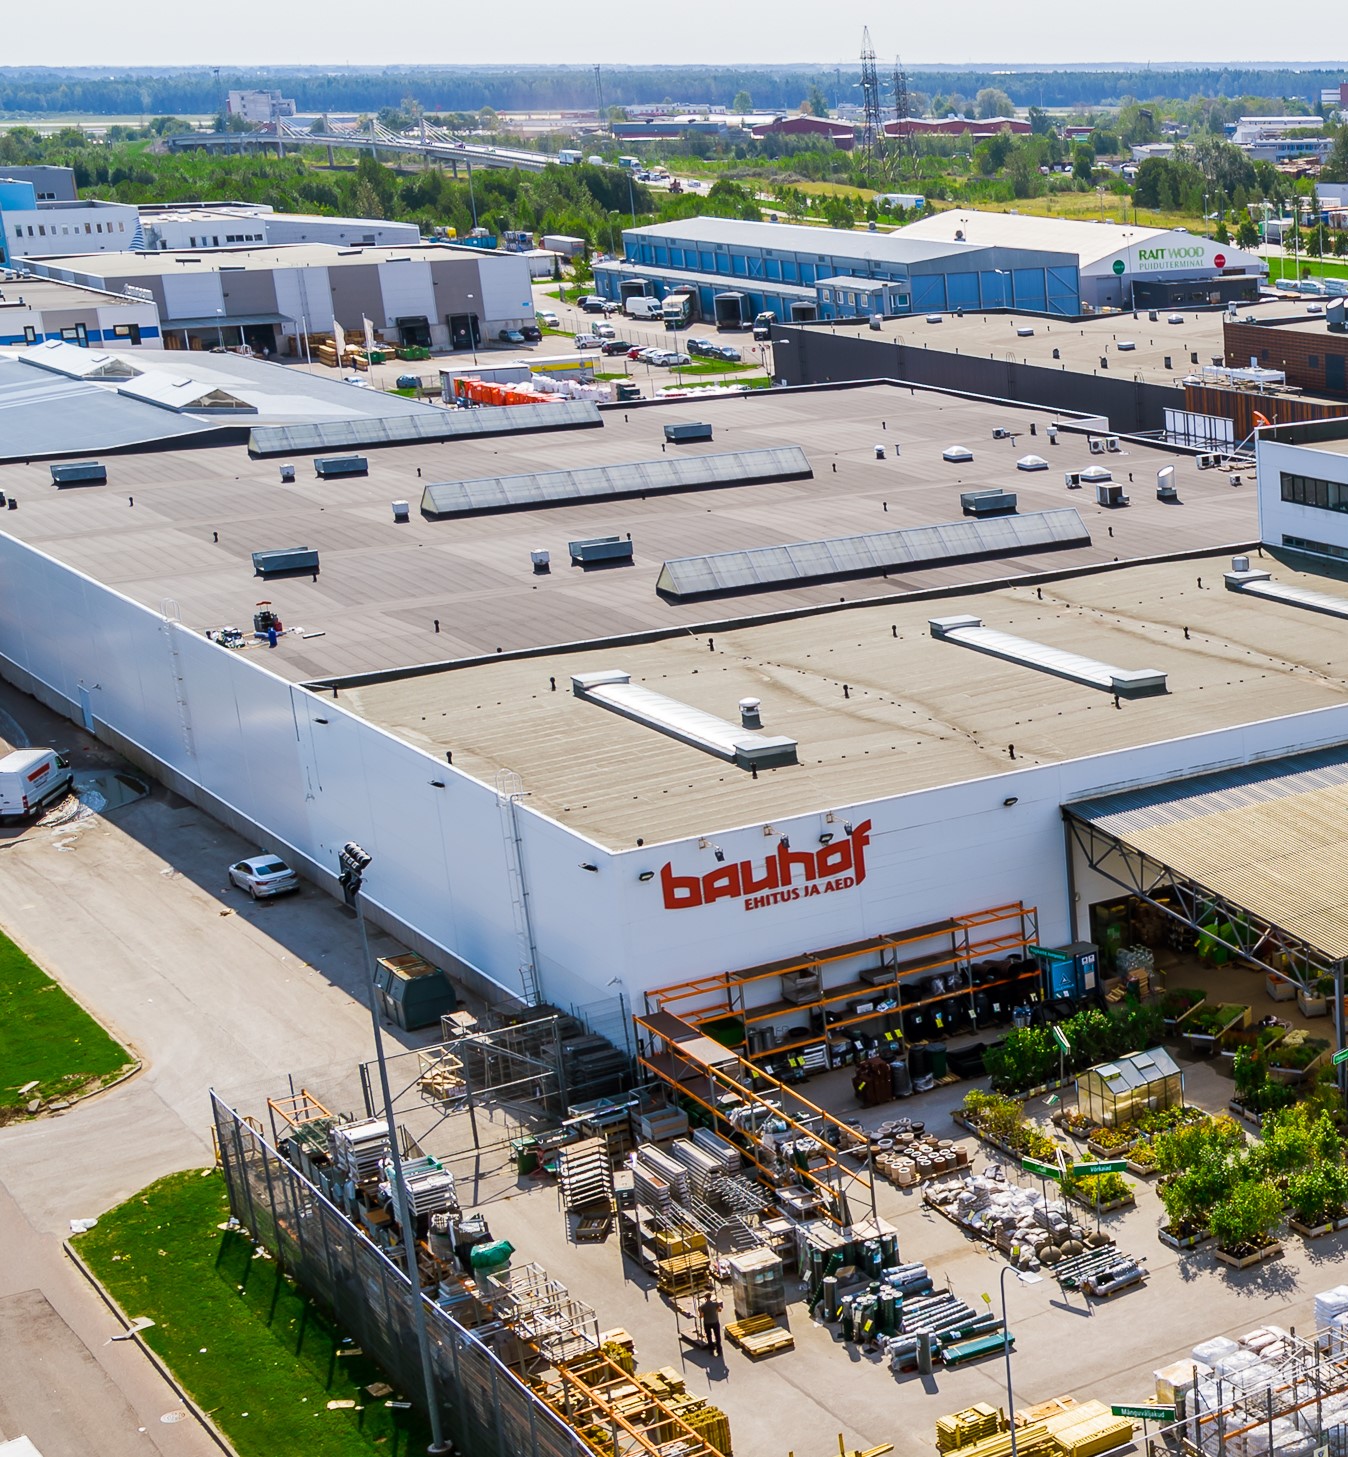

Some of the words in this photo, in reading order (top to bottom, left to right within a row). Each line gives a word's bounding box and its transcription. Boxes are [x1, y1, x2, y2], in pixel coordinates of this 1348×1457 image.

[1138, 248, 1166, 261] RAIT
[1168, 246, 1205, 258] WOOD
[1139, 260, 1205, 271] PUIDUTERMINAL
[660, 818, 872, 909] bauhof
[744, 888, 800, 911] EHITUS
[804, 884, 820, 898] JA
[824, 876, 855, 894] AED
